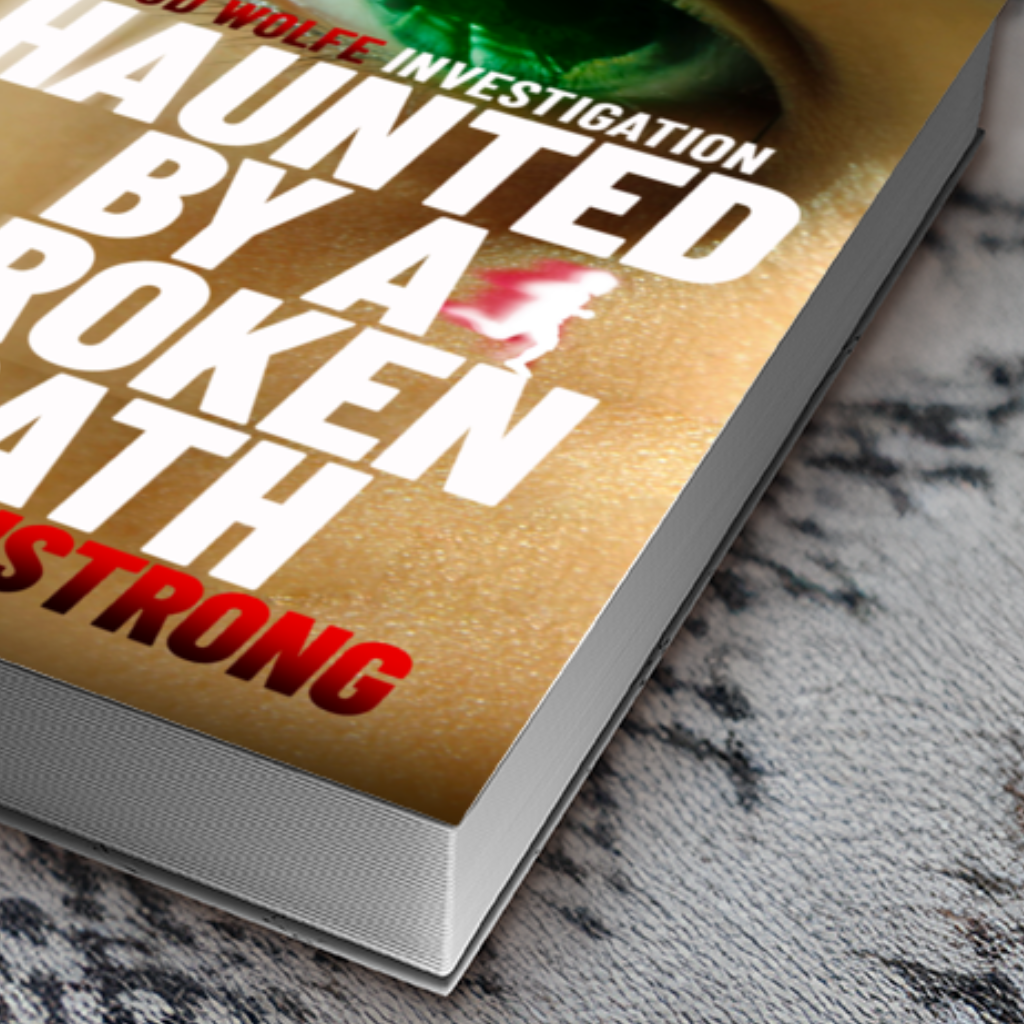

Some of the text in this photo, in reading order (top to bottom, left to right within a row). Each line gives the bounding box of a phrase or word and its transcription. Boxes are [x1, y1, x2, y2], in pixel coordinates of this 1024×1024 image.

[380, 47, 775, 176] INVESTIGATION
[38, 129, 489, 337] BY A
